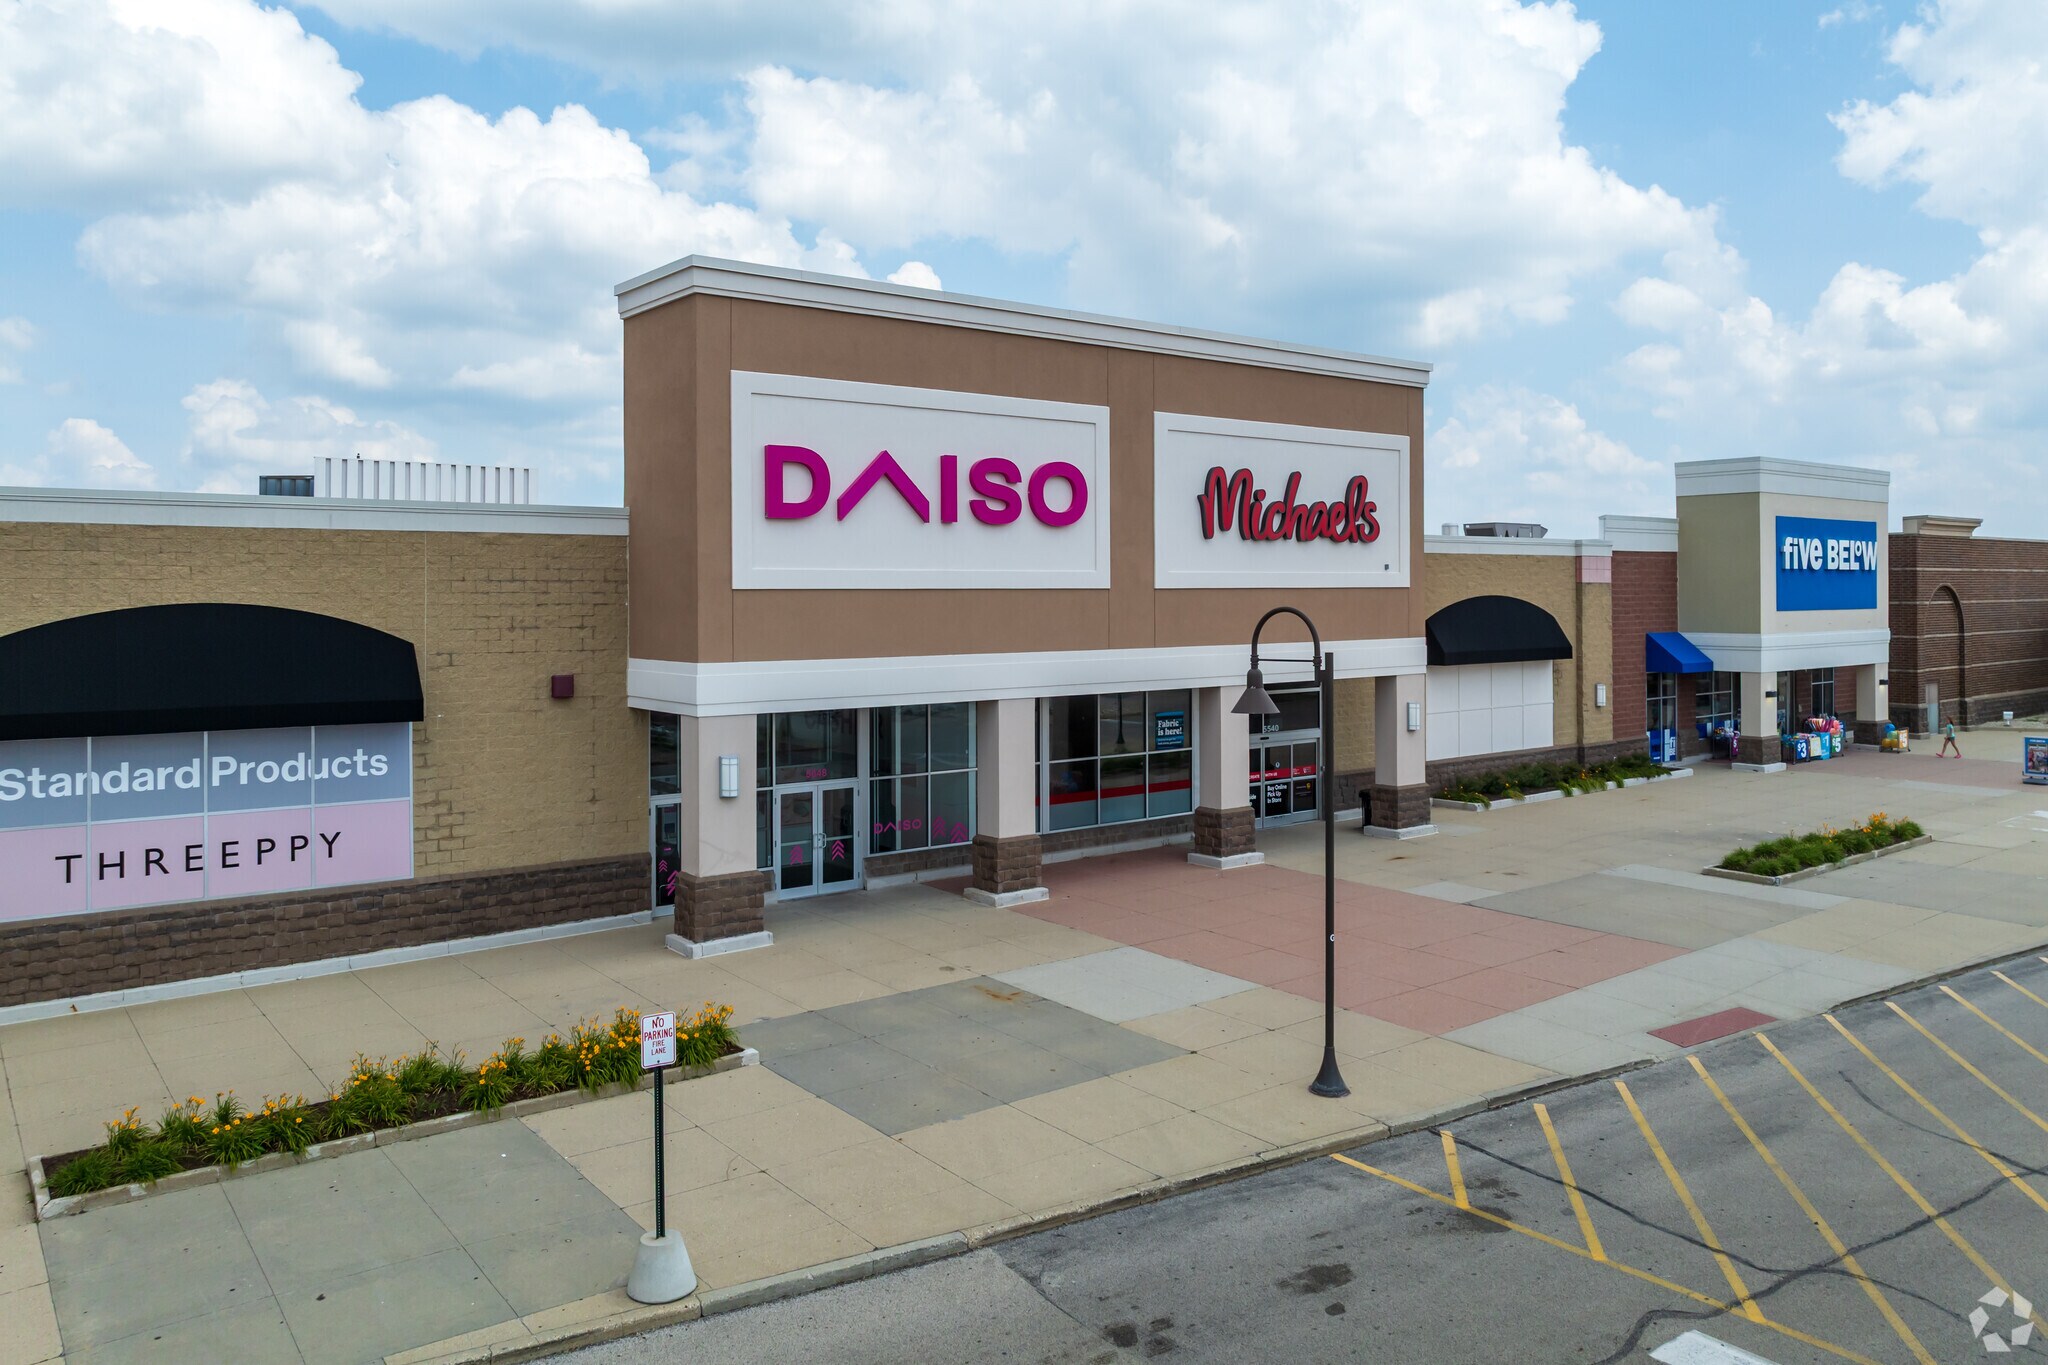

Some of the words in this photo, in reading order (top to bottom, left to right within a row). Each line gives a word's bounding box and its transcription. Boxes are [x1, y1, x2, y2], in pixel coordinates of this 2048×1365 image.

[764, 444, 1088, 527] DAISO
[1197, 466, 1380, 544] Michaels
[1783, 536, 1823, 571] five
[1157, 719, 1180, 728] Fabric
[1157, 728, 1164, 736] is
[1164, 727, 1183, 736] here!
[1797, 741, 1807, 758] $3
[1832, 737, 1842, 753] $5
[0, 757, 200, 801] Standard
[211, 748, 389, 787] Products
[55, 831, 342, 884] THREEPPY
[652, 1018, 664, 1028] NO
[644, 1028, 673, 1041] PARKING
[651, 1047, 666, 1055] LANE
